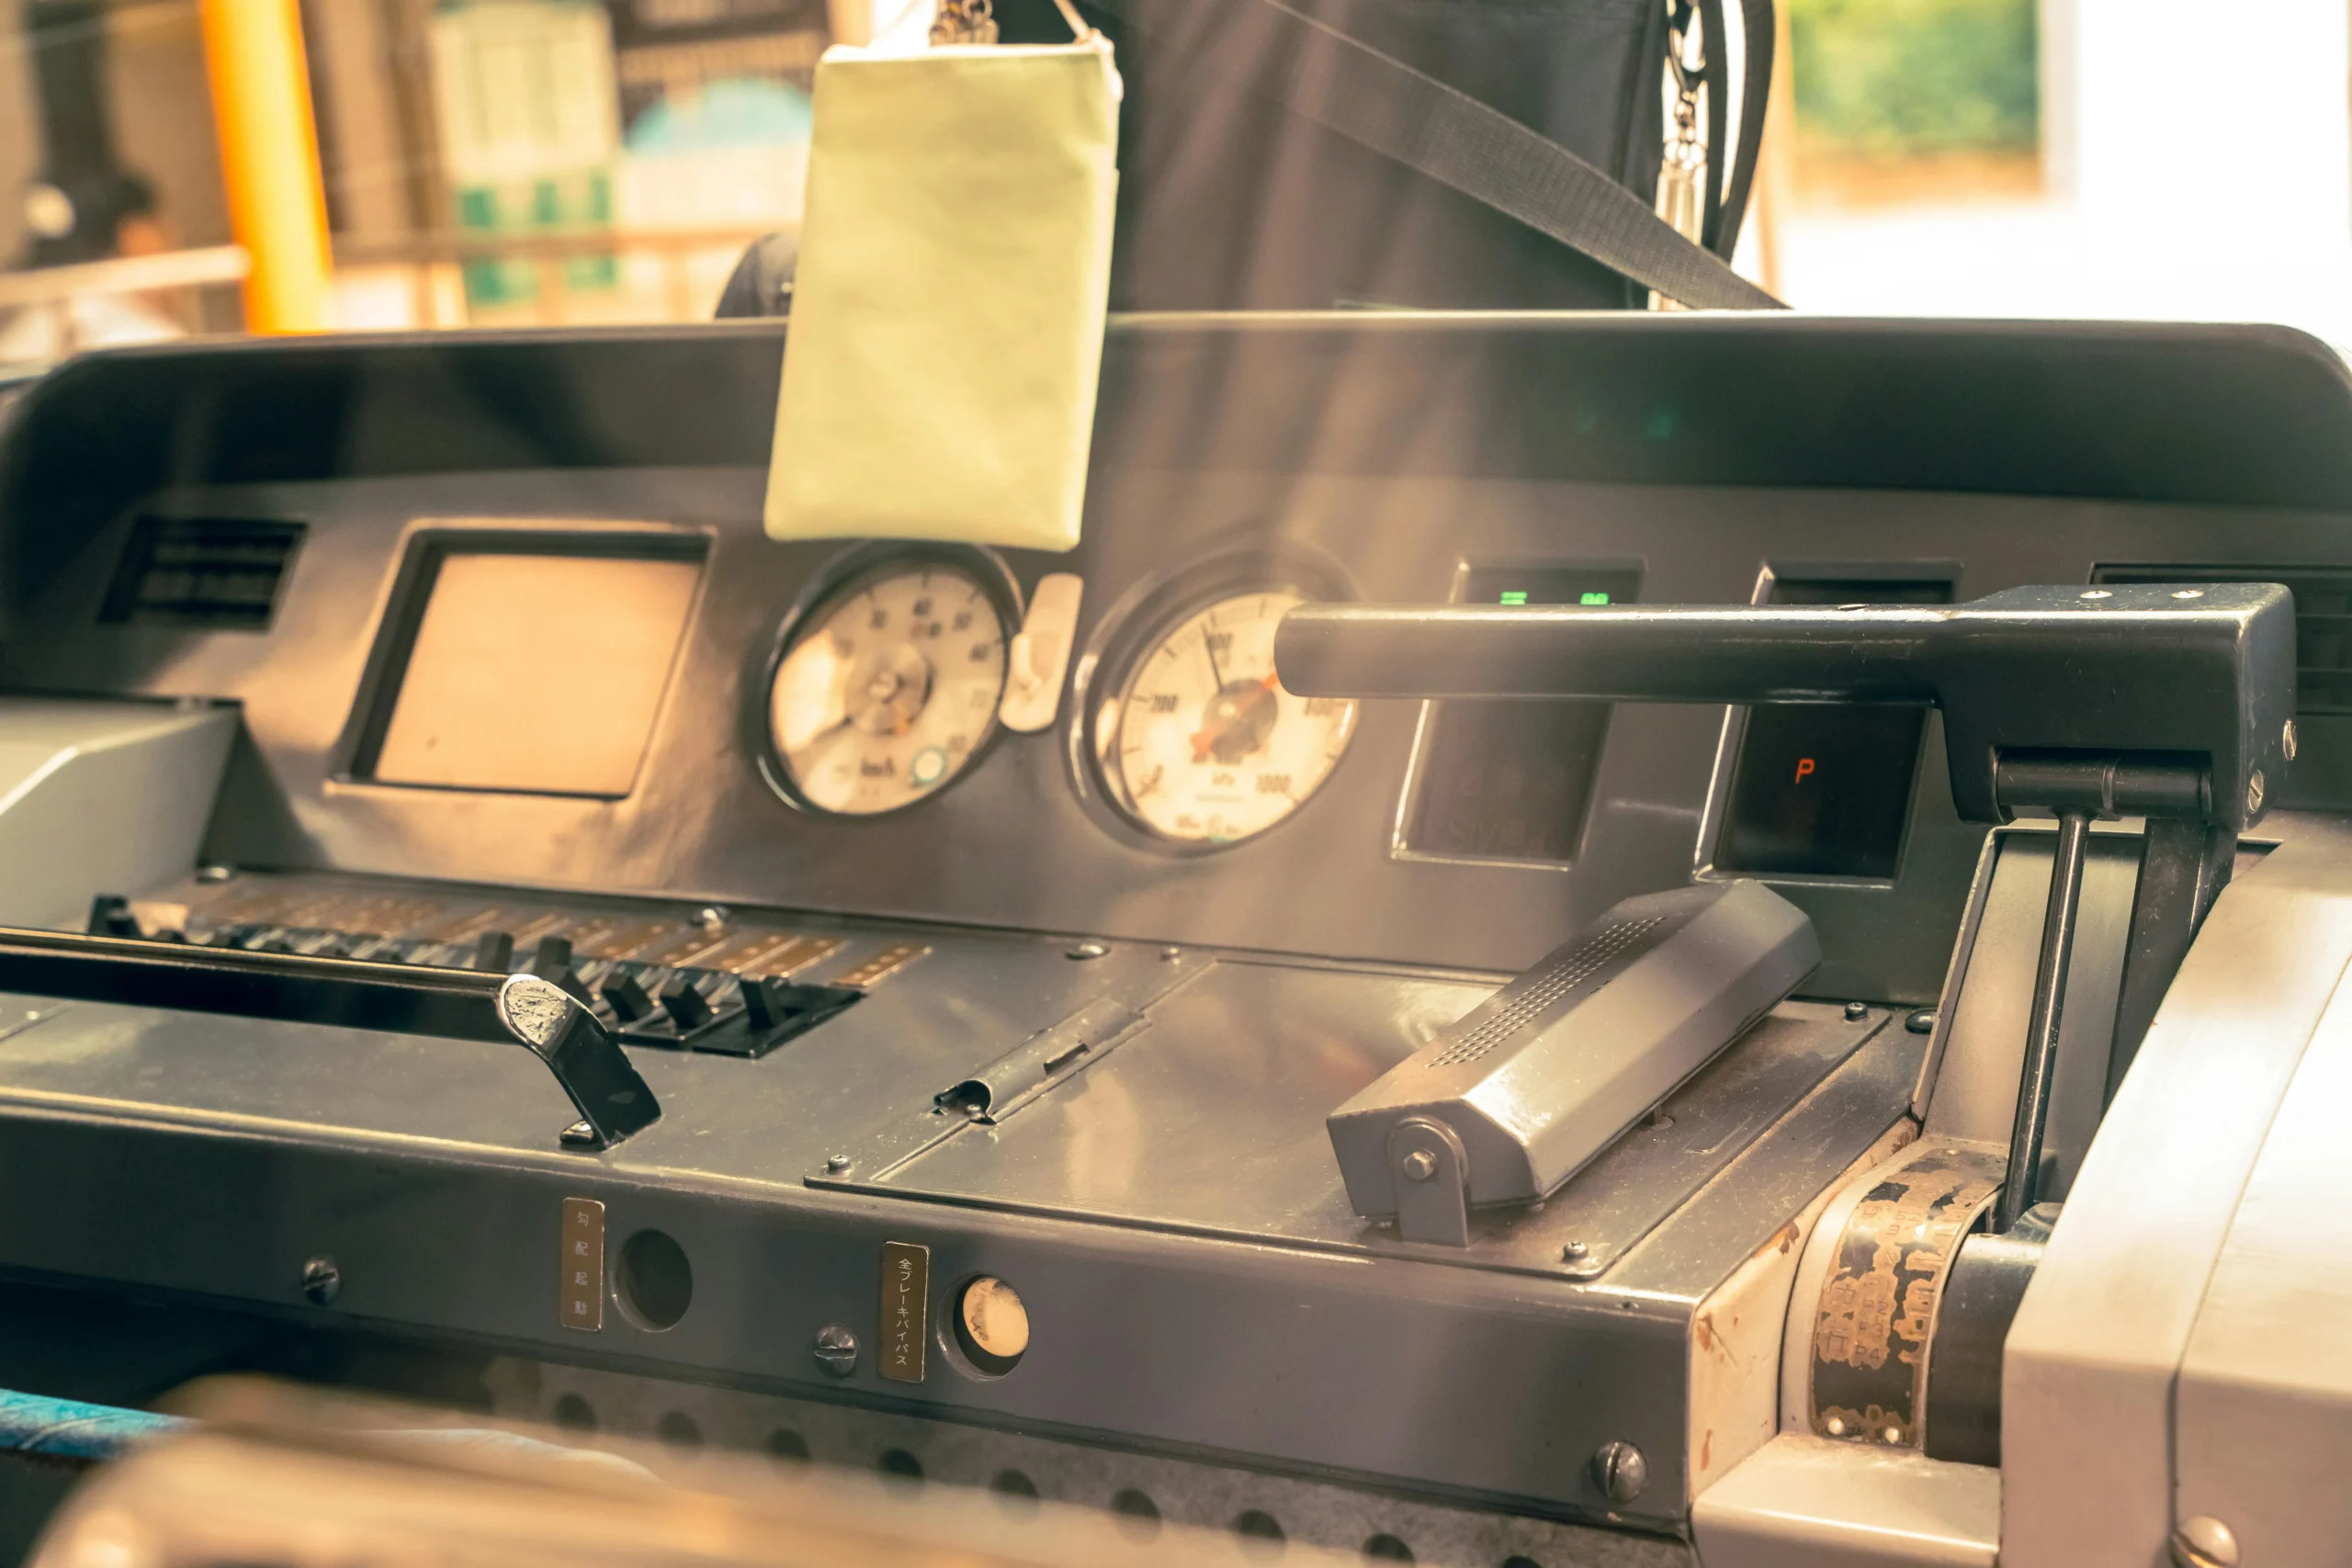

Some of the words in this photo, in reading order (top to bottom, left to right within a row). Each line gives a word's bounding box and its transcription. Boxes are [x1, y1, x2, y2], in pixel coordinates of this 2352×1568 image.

[1149, 694, 1178, 712] 200
[1795, 758, 1815, 784] P
[1256, 774, 1292, 793] 1000
[574, 1212, 589, 1315] 勾配起動
[896, 1258, 913, 1366] 全ブレーキバイパス
[1855, 1344, 1881, 1360] P4
